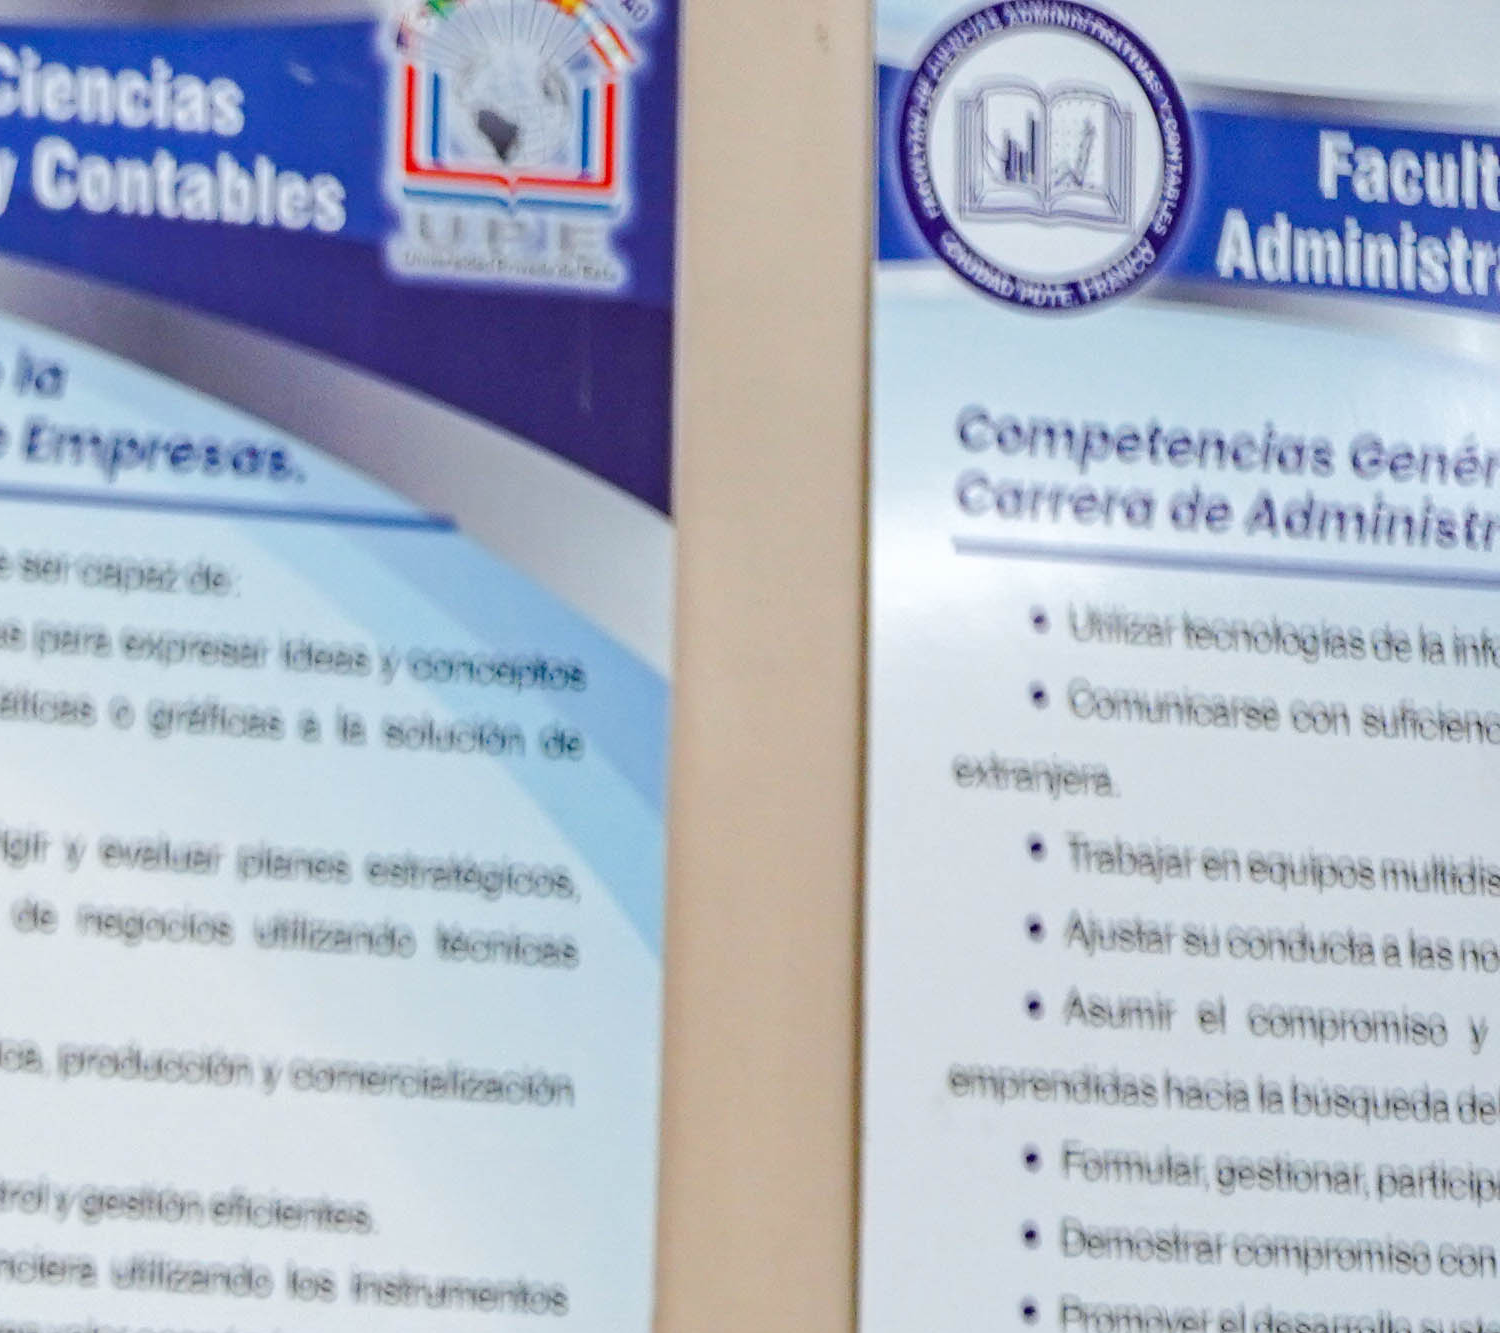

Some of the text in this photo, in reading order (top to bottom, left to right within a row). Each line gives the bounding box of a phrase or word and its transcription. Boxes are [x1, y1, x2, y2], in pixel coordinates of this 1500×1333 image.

[30, 135, 347, 233] Contables
[1216, 207, 1500, 296] Administr
[15, 341, 68, 399] la
[24, 412, 308, 487] Empresas.
[955, 404, 1336, 474] Competencias
[955, 468, 1156, 528] Carrera
[1168, 483, 1234, 533] de
[29, 620, 113, 663] para
[118, 627, 269, 673] expresar
[277, 636, 372, 679] ideas
[408, 640, 594, 697] conceptos
[1066, 676, 1280, 737] Comunicarse
[1289, 698, 1351, 738] con
[97, 833, 222, 877] evaluar
[234, 842, 352, 888] planes
[1067, 831, 1194, 886] Trabajar
[1199, 846, 1241, 884] en
[1246, 846, 1376, 898] equipos
[1063, 985, 1487, 1059] Asumir el compromiso y
[1057, 1215, 1497, 1282] Demostrar compromiso con
